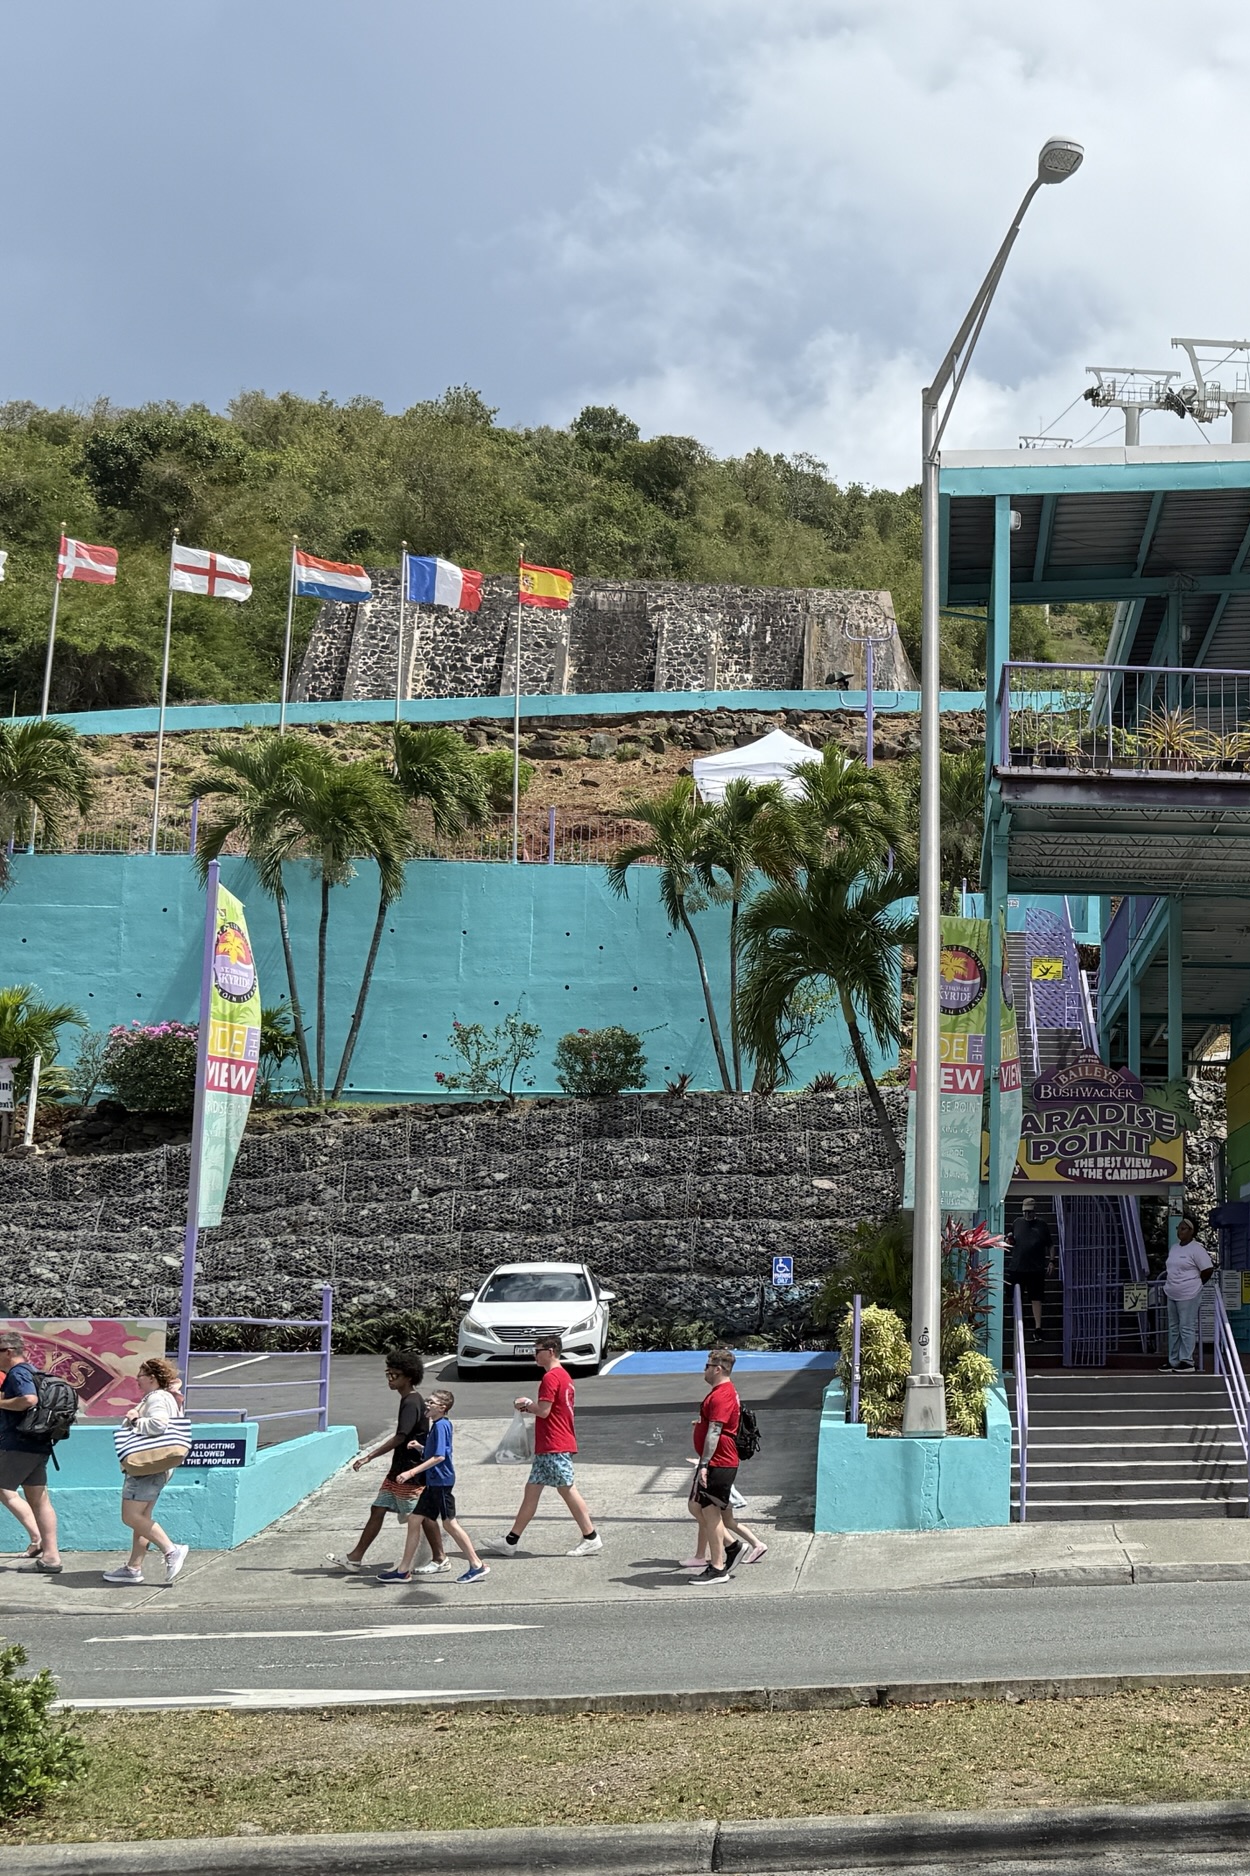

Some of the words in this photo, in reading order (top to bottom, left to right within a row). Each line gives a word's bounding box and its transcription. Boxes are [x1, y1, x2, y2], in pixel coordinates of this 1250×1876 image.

[972, 1036, 983, 1061] THE
[1058, 1065, 1119, 1085] BAILEYS
[1020, 1103, 1177, 1137] ARADISE
[1031, 1128, 1150, 1162] POINT
[1074, 1158, 1095, 1168] THE
[1096, 1156, 1122, 1169] BEST
[1124, 1156, 1152, 1169] VIEW
[1067, 1168, 1080, 1177] IN
[1082, 1169, 1103, 1180] THE
[1105, 1168, 1168, 1181] CARIBBEAN
[190, 1450, 226, 1458] ALLOWED
[193, 1442, 236, 1450] SOLICITING
